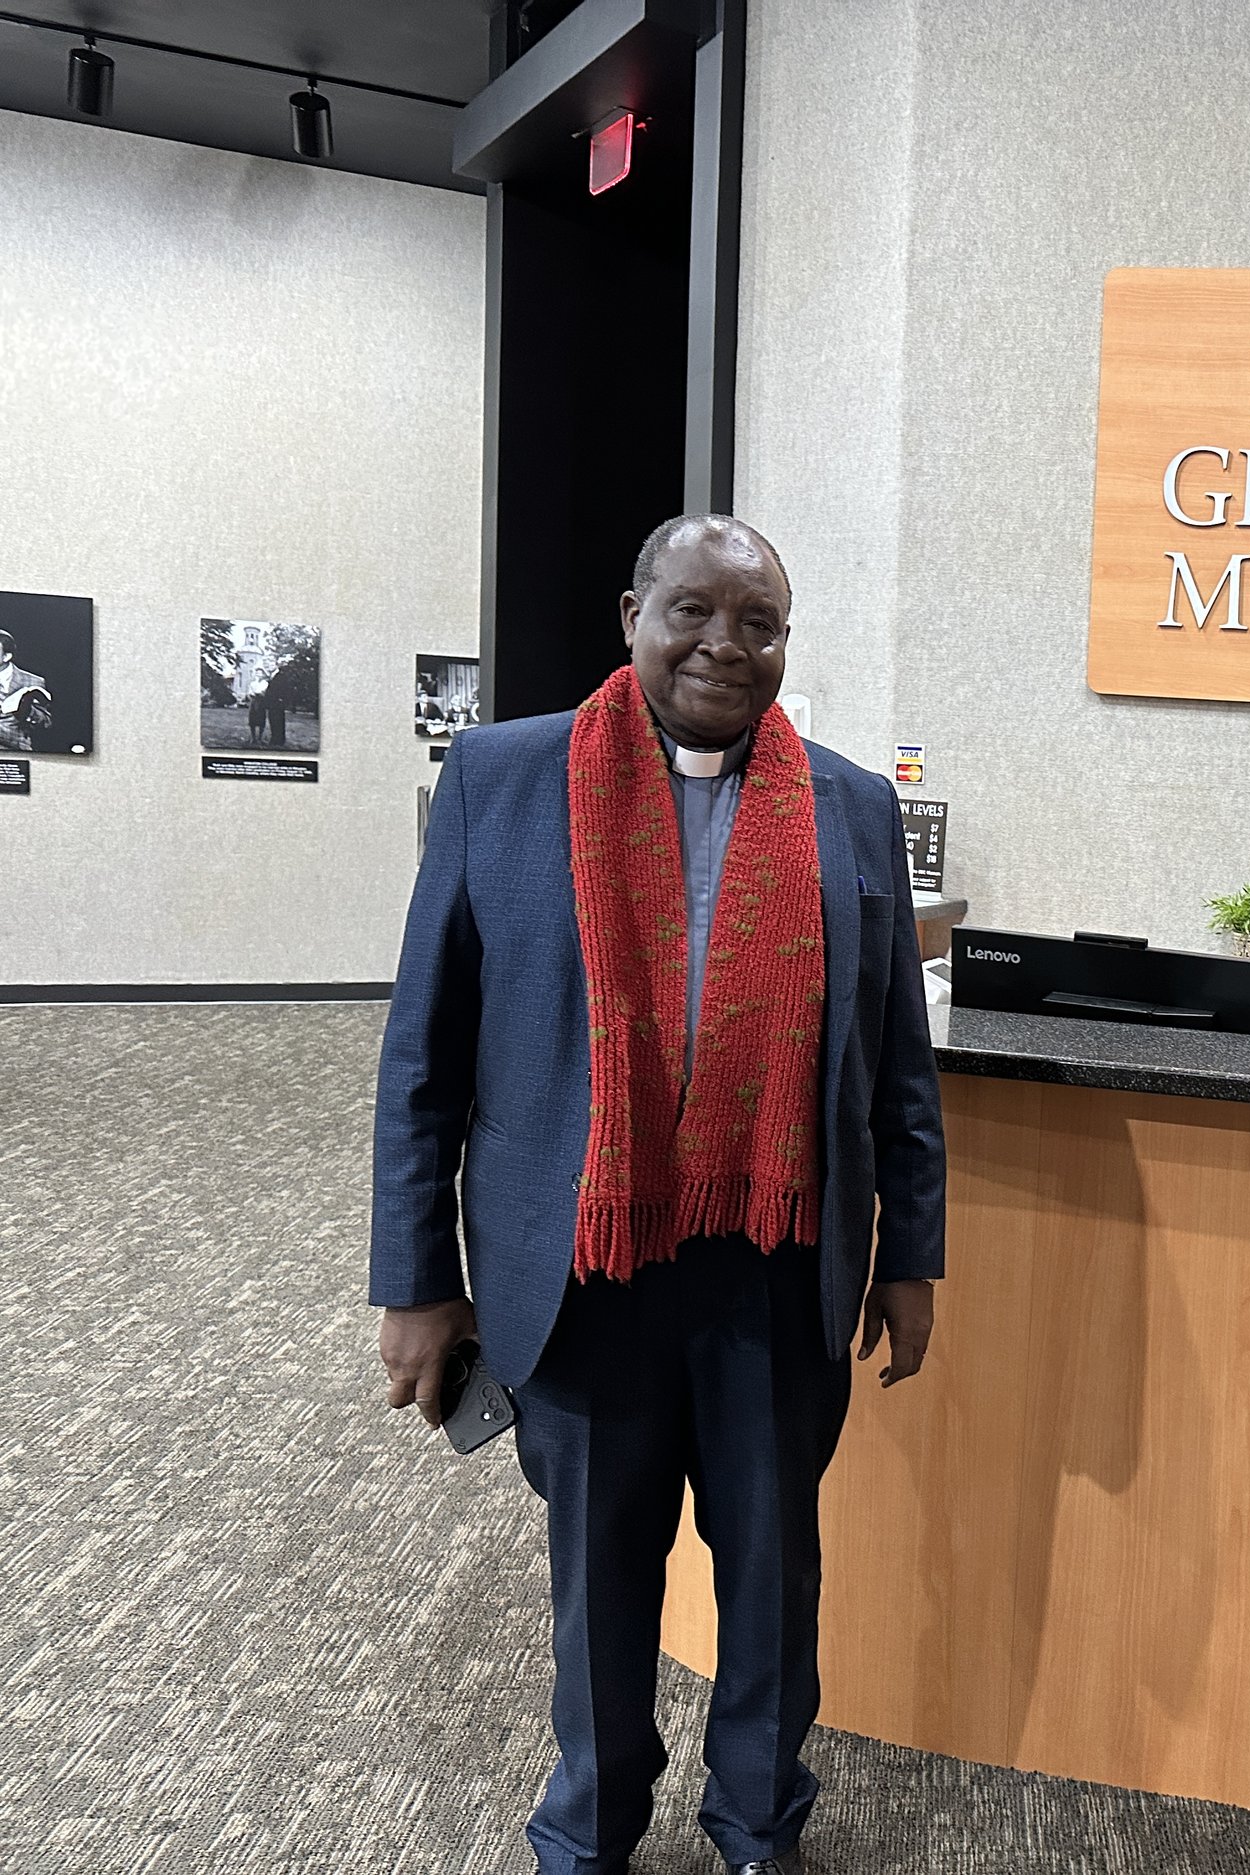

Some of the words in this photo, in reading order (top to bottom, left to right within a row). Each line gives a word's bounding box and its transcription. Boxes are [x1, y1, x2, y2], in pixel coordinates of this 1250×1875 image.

[901, 750, 919, 758] VISA
[912, 803, 945, 817] LEVELS
[967, 945, 1021, 964] Lenovo
